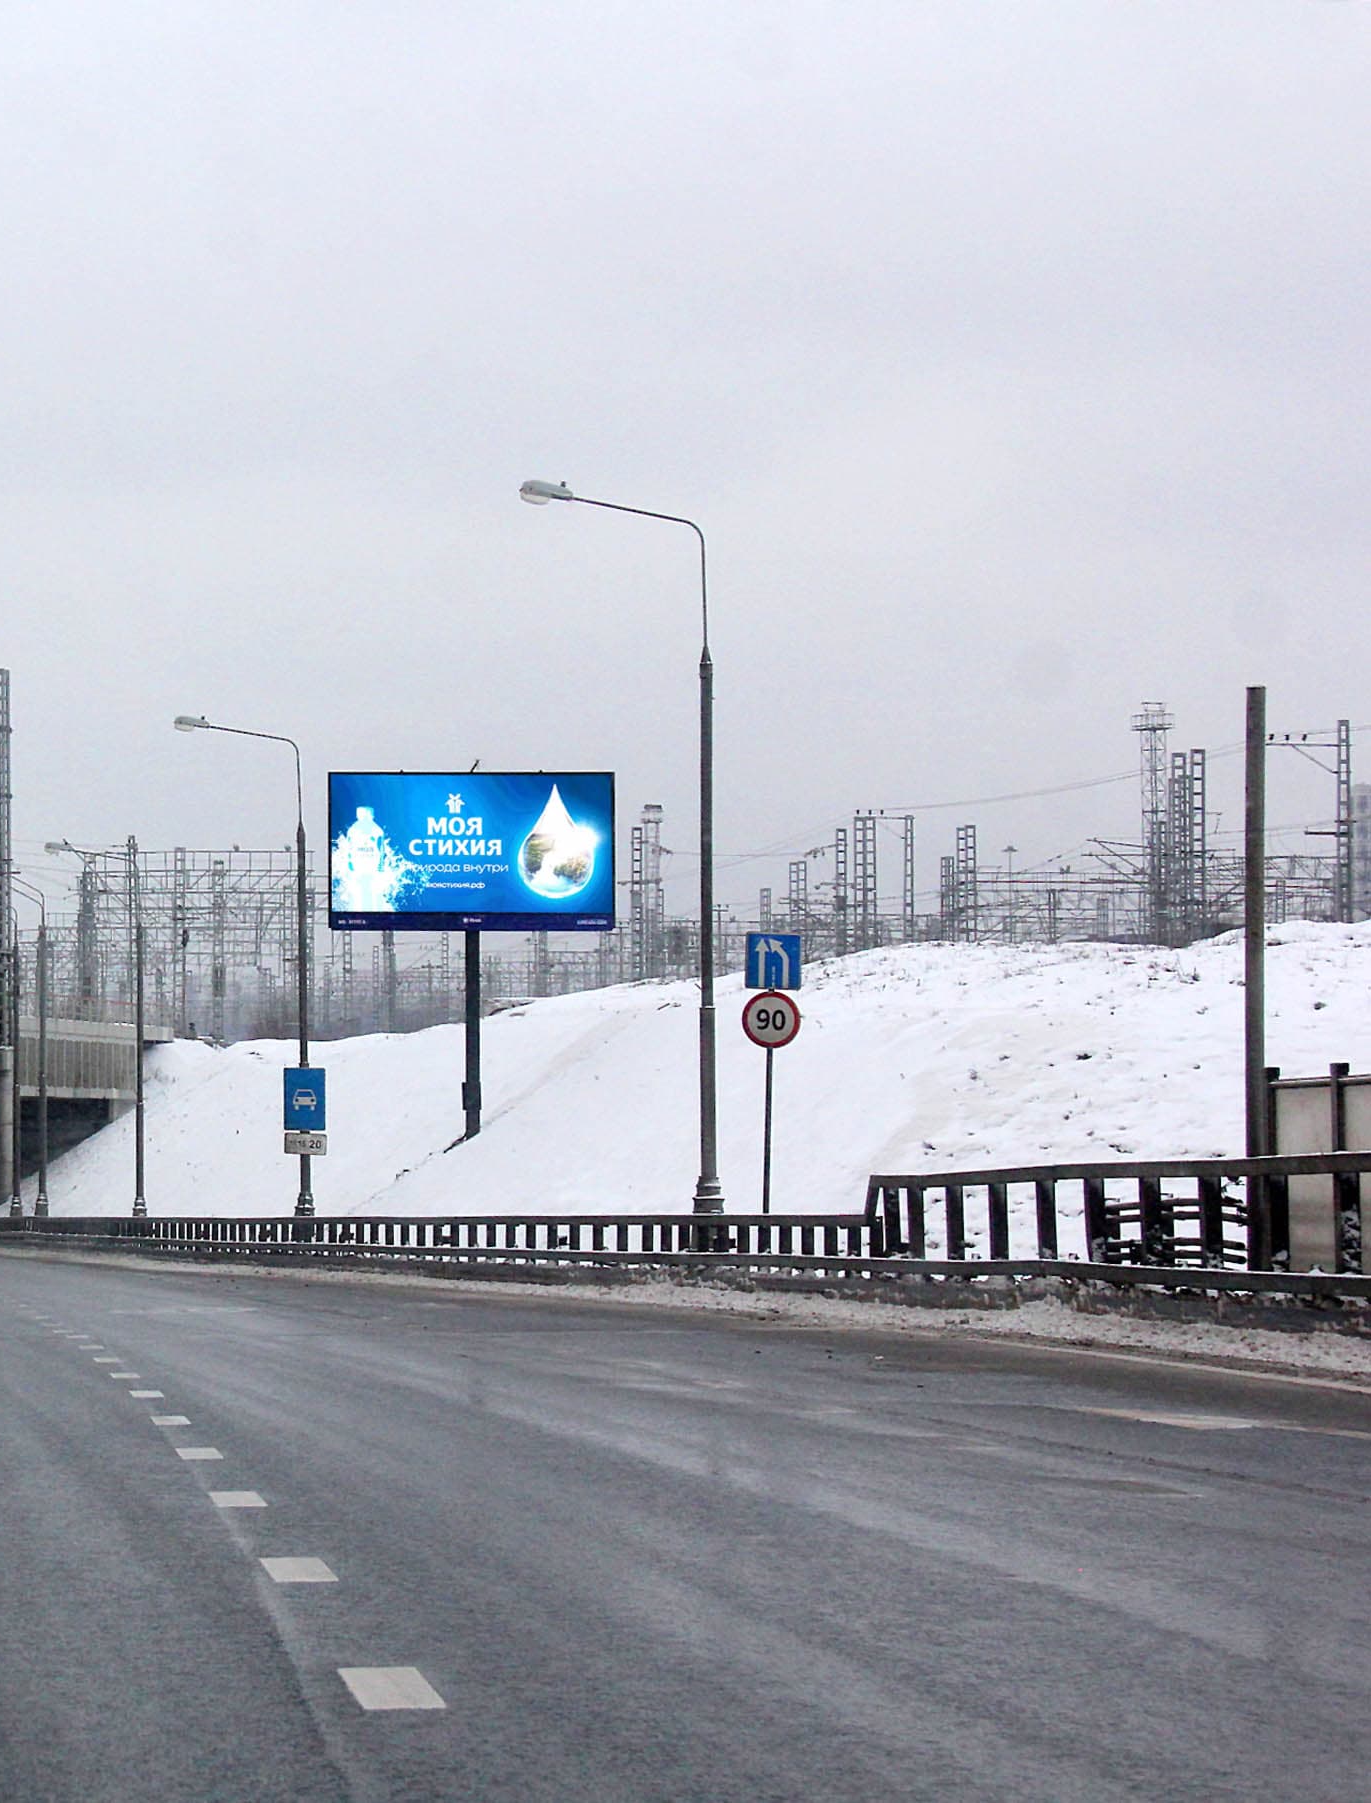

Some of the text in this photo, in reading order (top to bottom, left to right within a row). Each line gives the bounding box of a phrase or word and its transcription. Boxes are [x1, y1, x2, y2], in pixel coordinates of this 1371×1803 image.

[427, 817, 483, 836] МОЯ
[408, 839, 502, 856] СТИХИЯ
[463, 864, 509, 874] внутри
[756, 1008, 786, 1031] 90
[309, 1139, 322, 1149] 20
